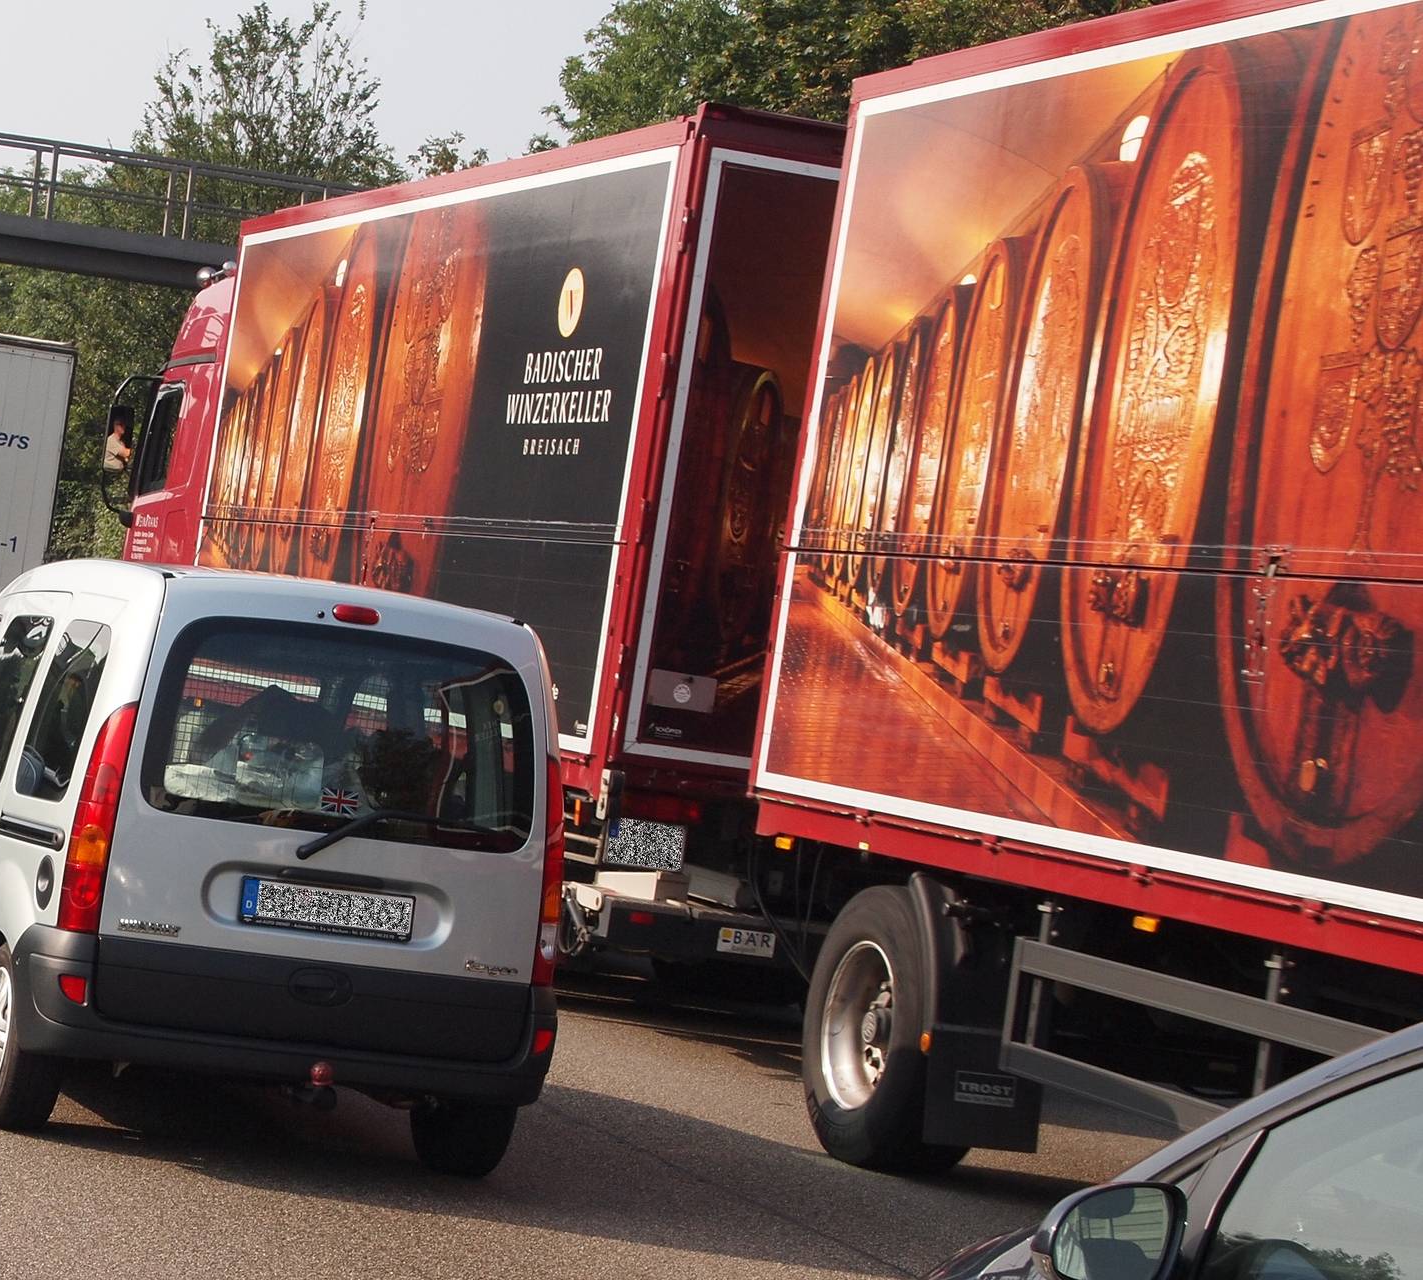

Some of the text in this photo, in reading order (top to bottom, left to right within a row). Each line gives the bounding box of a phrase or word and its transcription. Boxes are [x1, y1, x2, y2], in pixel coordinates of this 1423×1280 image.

[523, 347, 603, 385] BADISCHER
[505, 389, 612, 425] WINZERKELLER
[522, 438, 581, 456] BREISACH
[245, 900, 253, 909] D
[733, 930, 772, 949] BÄR
[958, 1080, 1012, 1097] TROST
